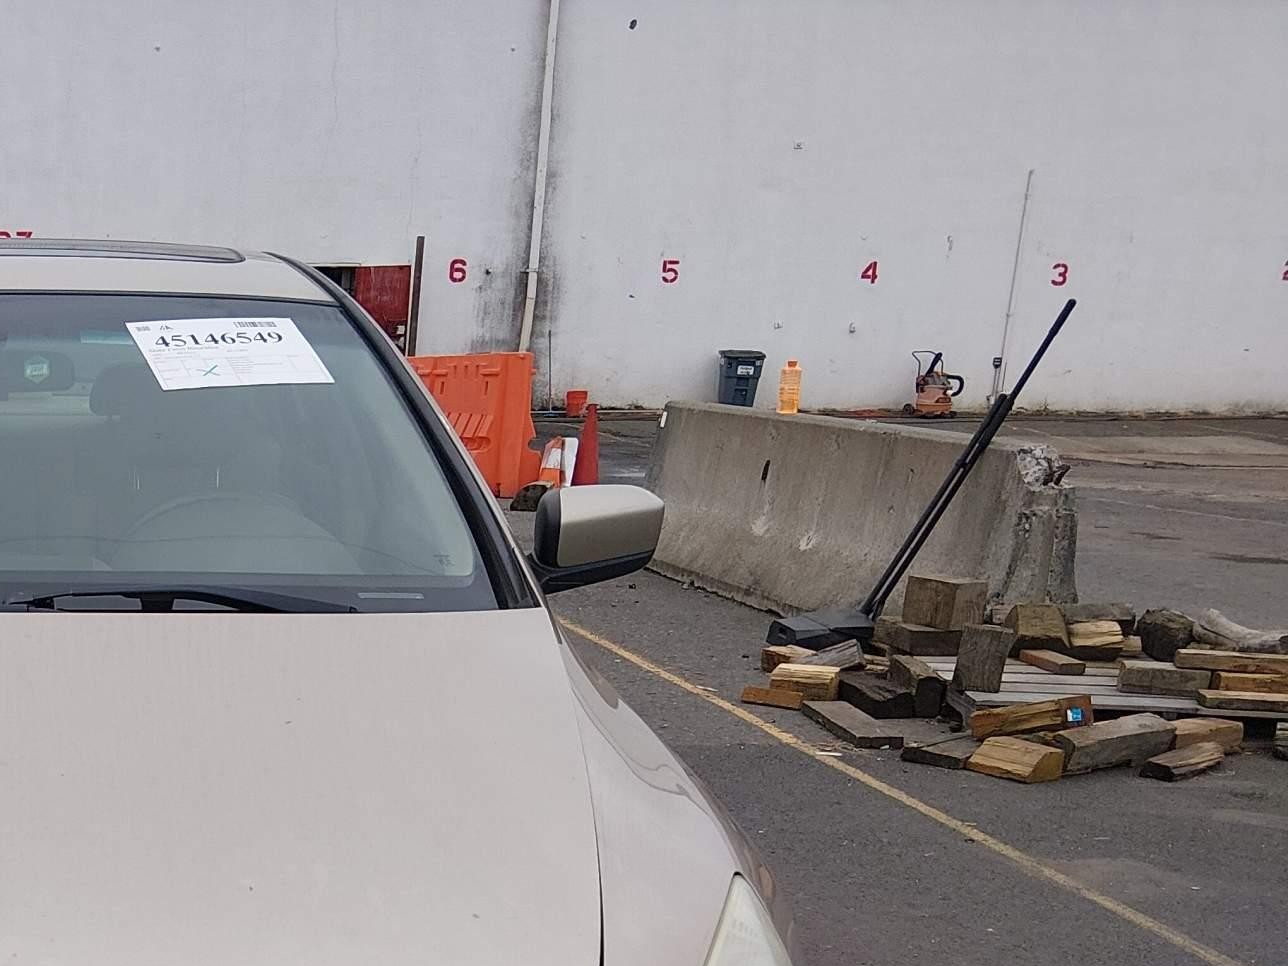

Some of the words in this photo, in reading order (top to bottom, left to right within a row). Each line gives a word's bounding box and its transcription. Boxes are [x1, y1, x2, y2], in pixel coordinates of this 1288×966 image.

[448, 258, 467, 283] 6
[662, 259, 680, 284] 5
[861, 261, 878, 284] 4
[1051, 263, 1069, 287] 3
[155, 331, 283, 347] 45146549
